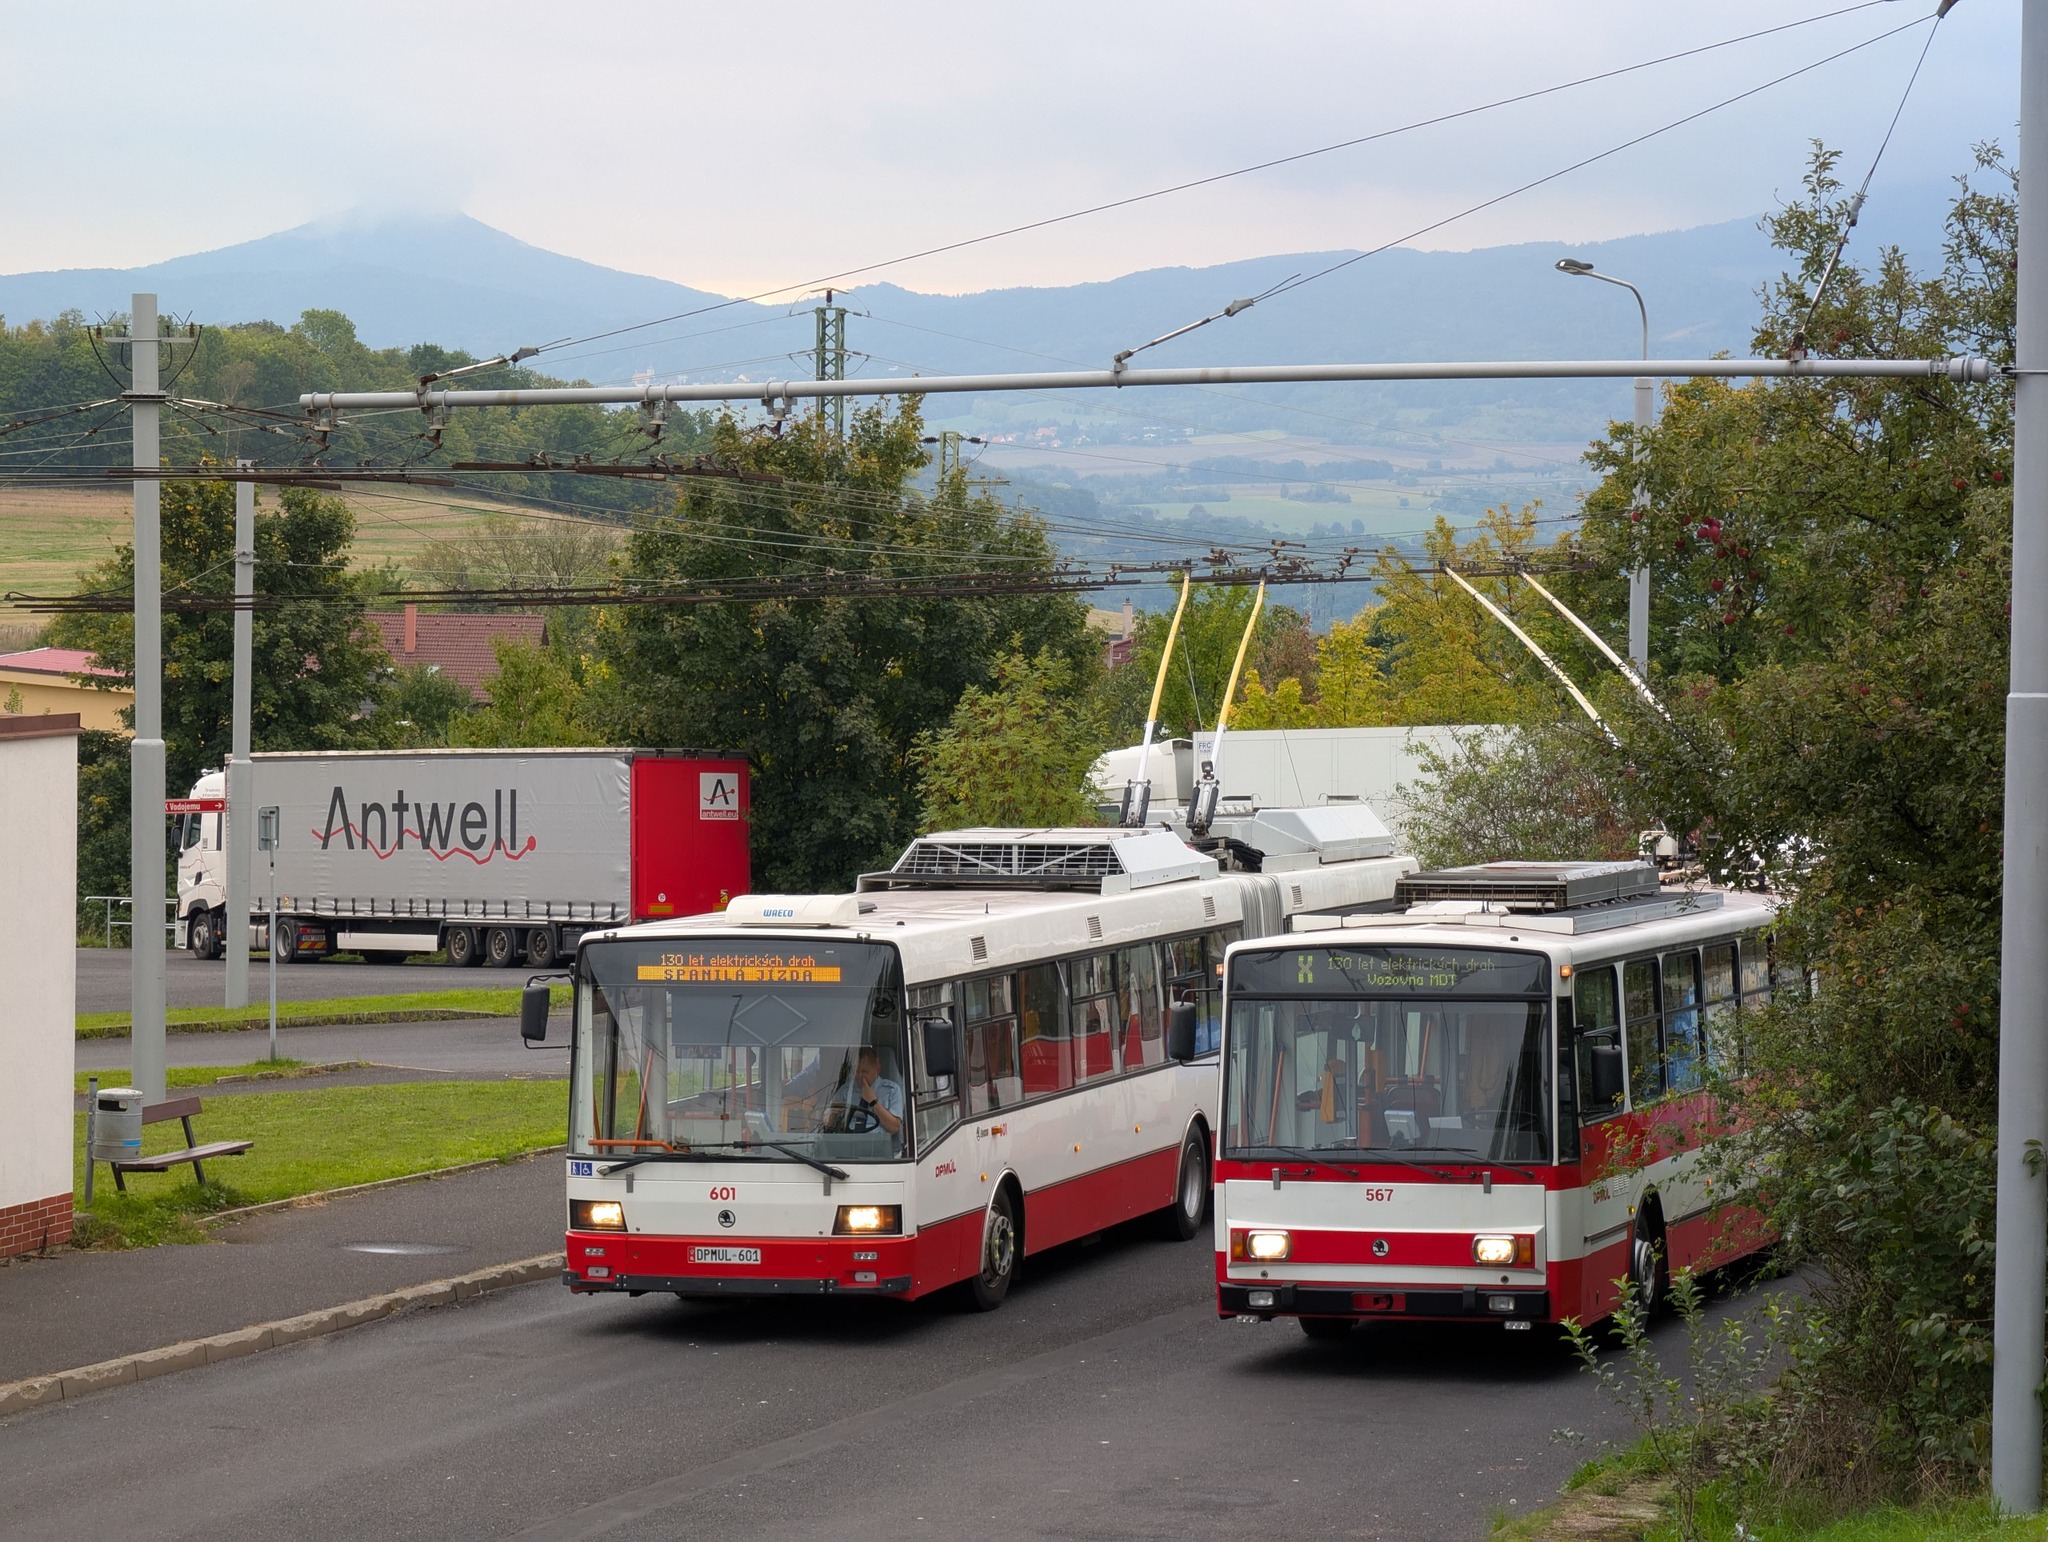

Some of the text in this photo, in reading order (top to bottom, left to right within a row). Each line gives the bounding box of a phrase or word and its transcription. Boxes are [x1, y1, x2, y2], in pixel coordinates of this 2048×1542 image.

[1198, 741, 1212, 750] FRC
[710, 779, 730, 805] A
[169, 802, 201, 812] Vodojemu
[702, 810, 737, 818] antwell.eu
[321, 787, 516, 850] Antwell
[763, 909, 794, 917] WAECO
[660, 953, 816, 967] 130 let elektrických drah
[1327, 956, 1495, 971] 130 let elektrických drah
[1298, 955, 1314, 984] X
[1367, 973, 1457, 987] Vozovna MDT
[709, 1187, 736, 1201] 601
[1366, 1188, 1394, 1202] 567
[696, 1248, 759, 1262] DPMUL-601
